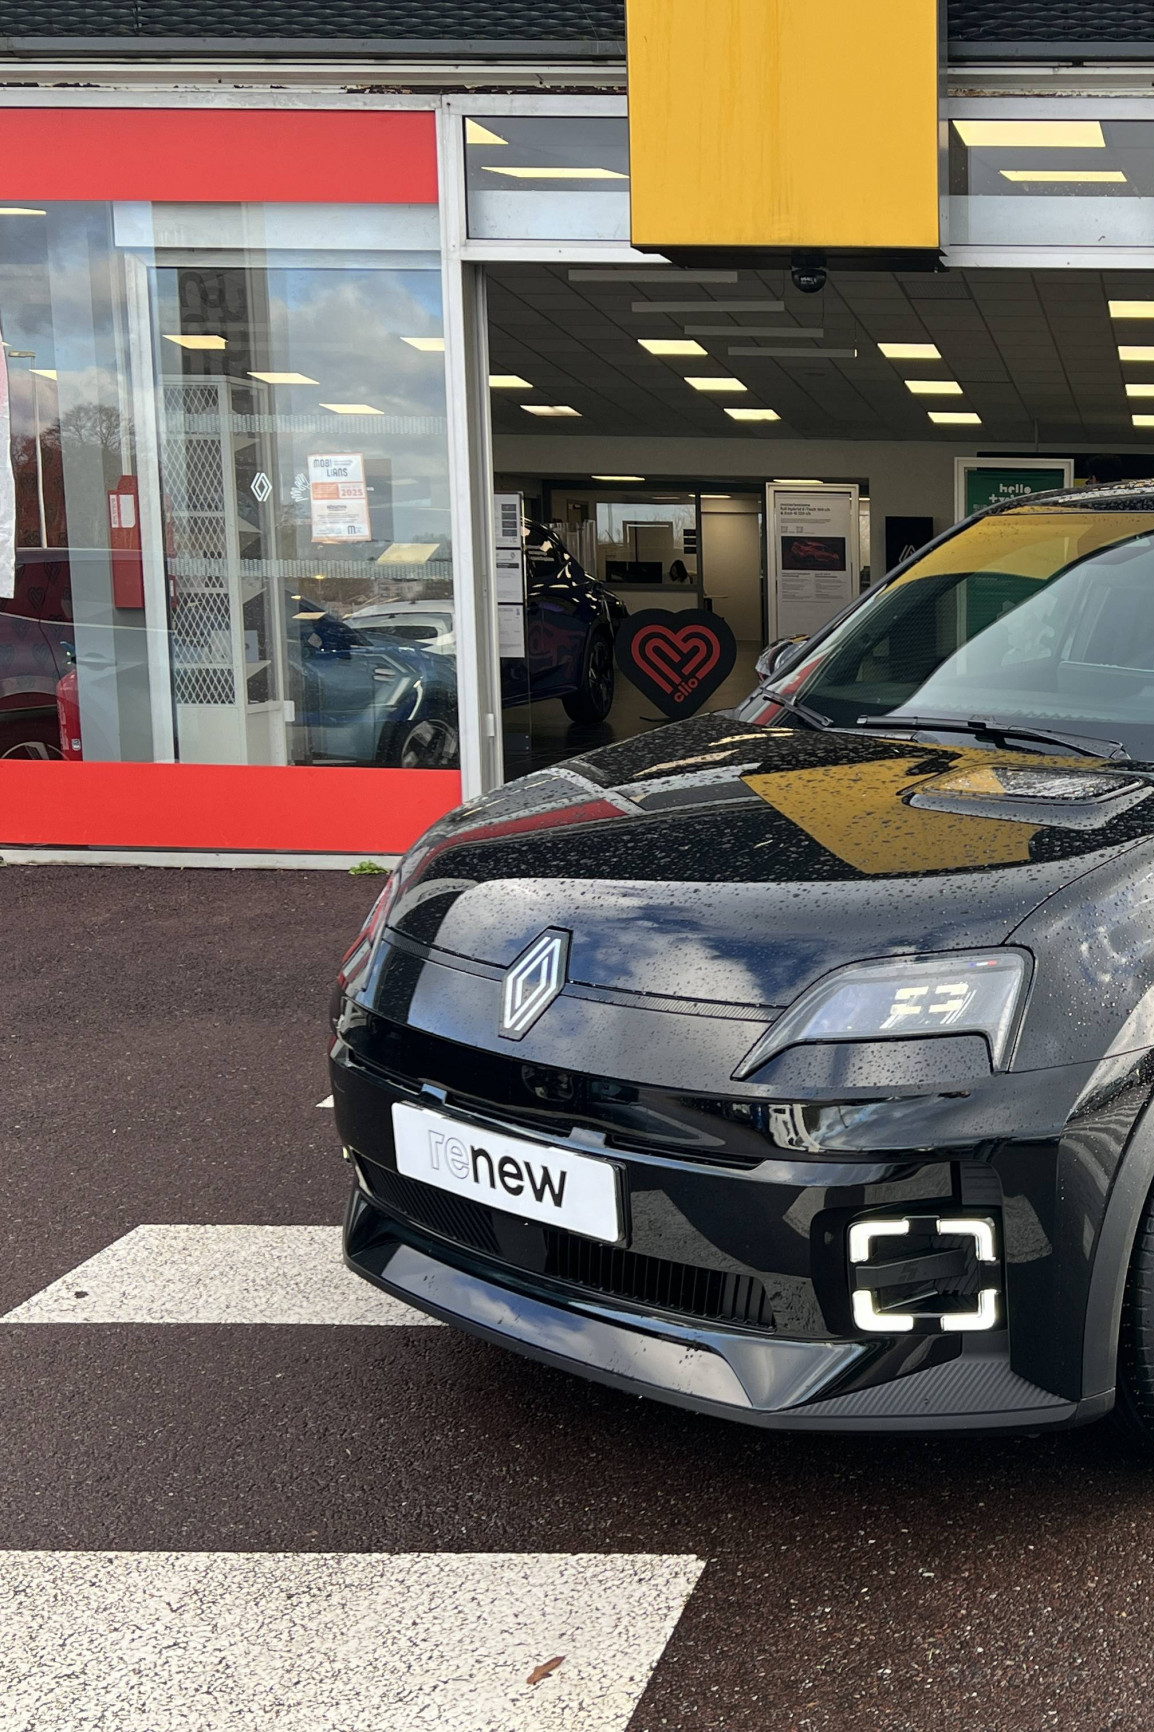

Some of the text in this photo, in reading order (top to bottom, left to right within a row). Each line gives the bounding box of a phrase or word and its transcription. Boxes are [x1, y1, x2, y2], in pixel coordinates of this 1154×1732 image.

[341, 488, 364, 497] 2025
[999, 483, 1031, 494] hello
[674, 678, 698, 703] clio
[428, 1129, 568, 1208] renew
